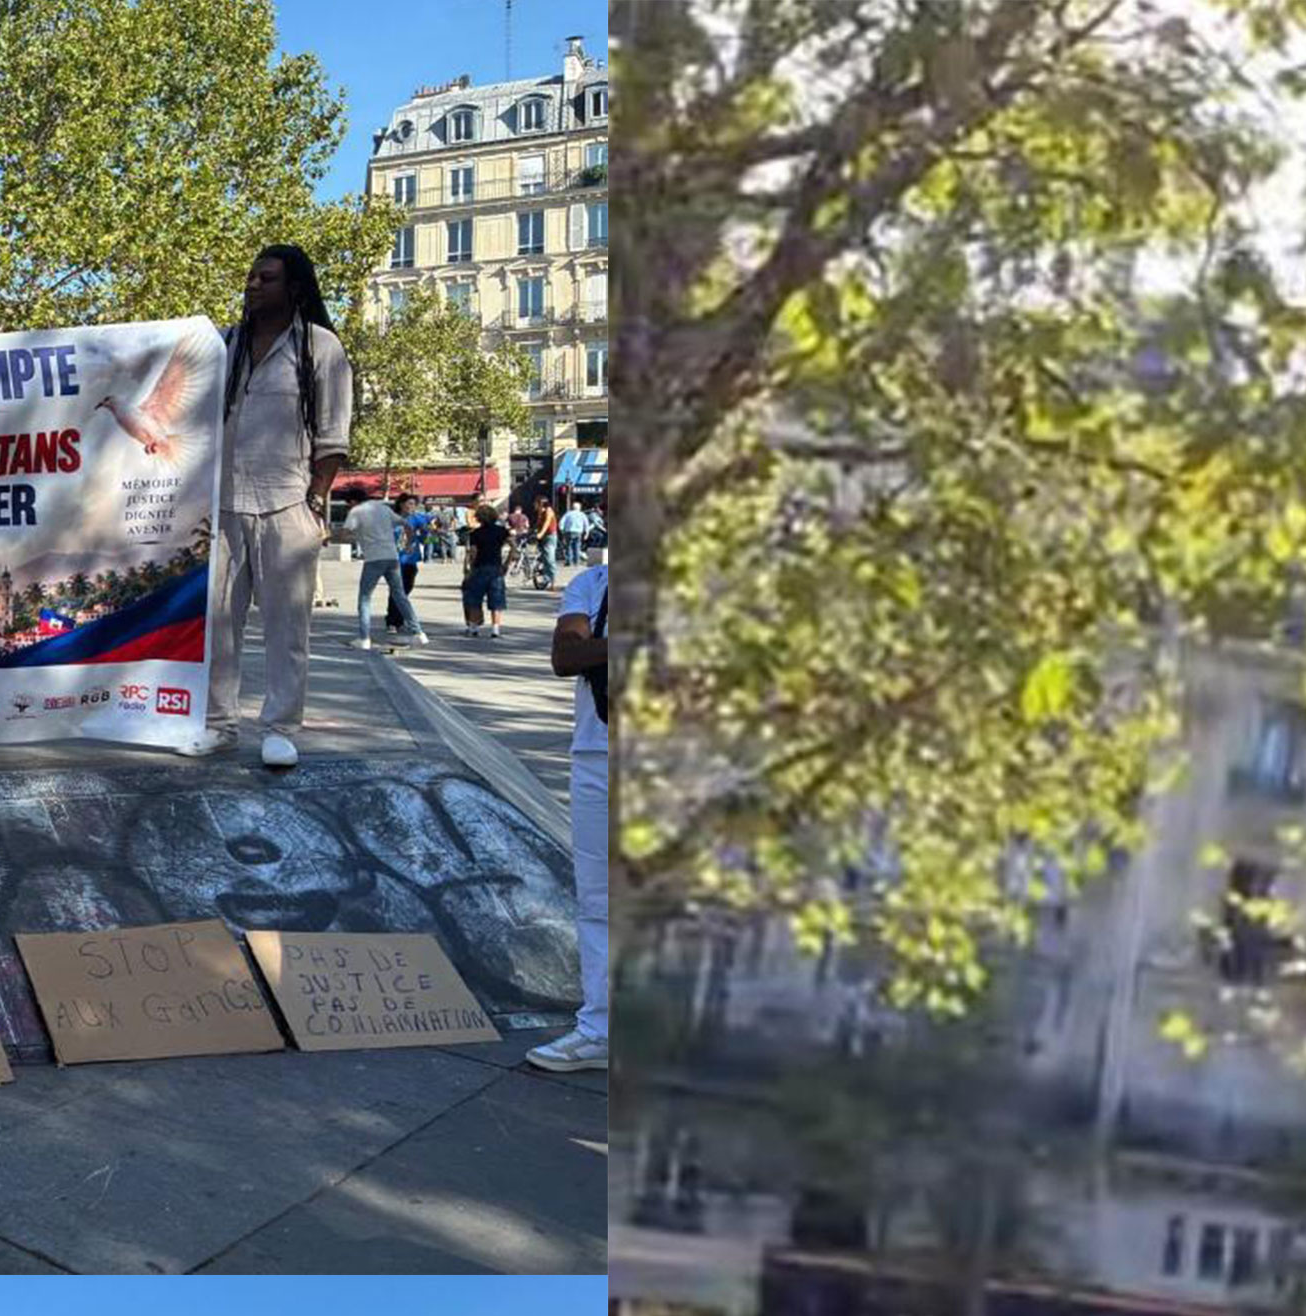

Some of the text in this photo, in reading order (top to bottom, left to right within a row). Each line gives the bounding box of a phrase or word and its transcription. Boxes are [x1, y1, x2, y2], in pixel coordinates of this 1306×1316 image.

[125, 493, 176, 508] JUSTICE
[126, 523, 172, 535] AVENIR
[157, 692, 189, 714] RSI
[78, 929, 198, 980] STOP
[285, 944, 349, 970] PAS
[298, 971, 434, 995] JUSTICE
[57, 1001, 122, 1029] AUX
[312, 996, 417, 1015] PAS DE
